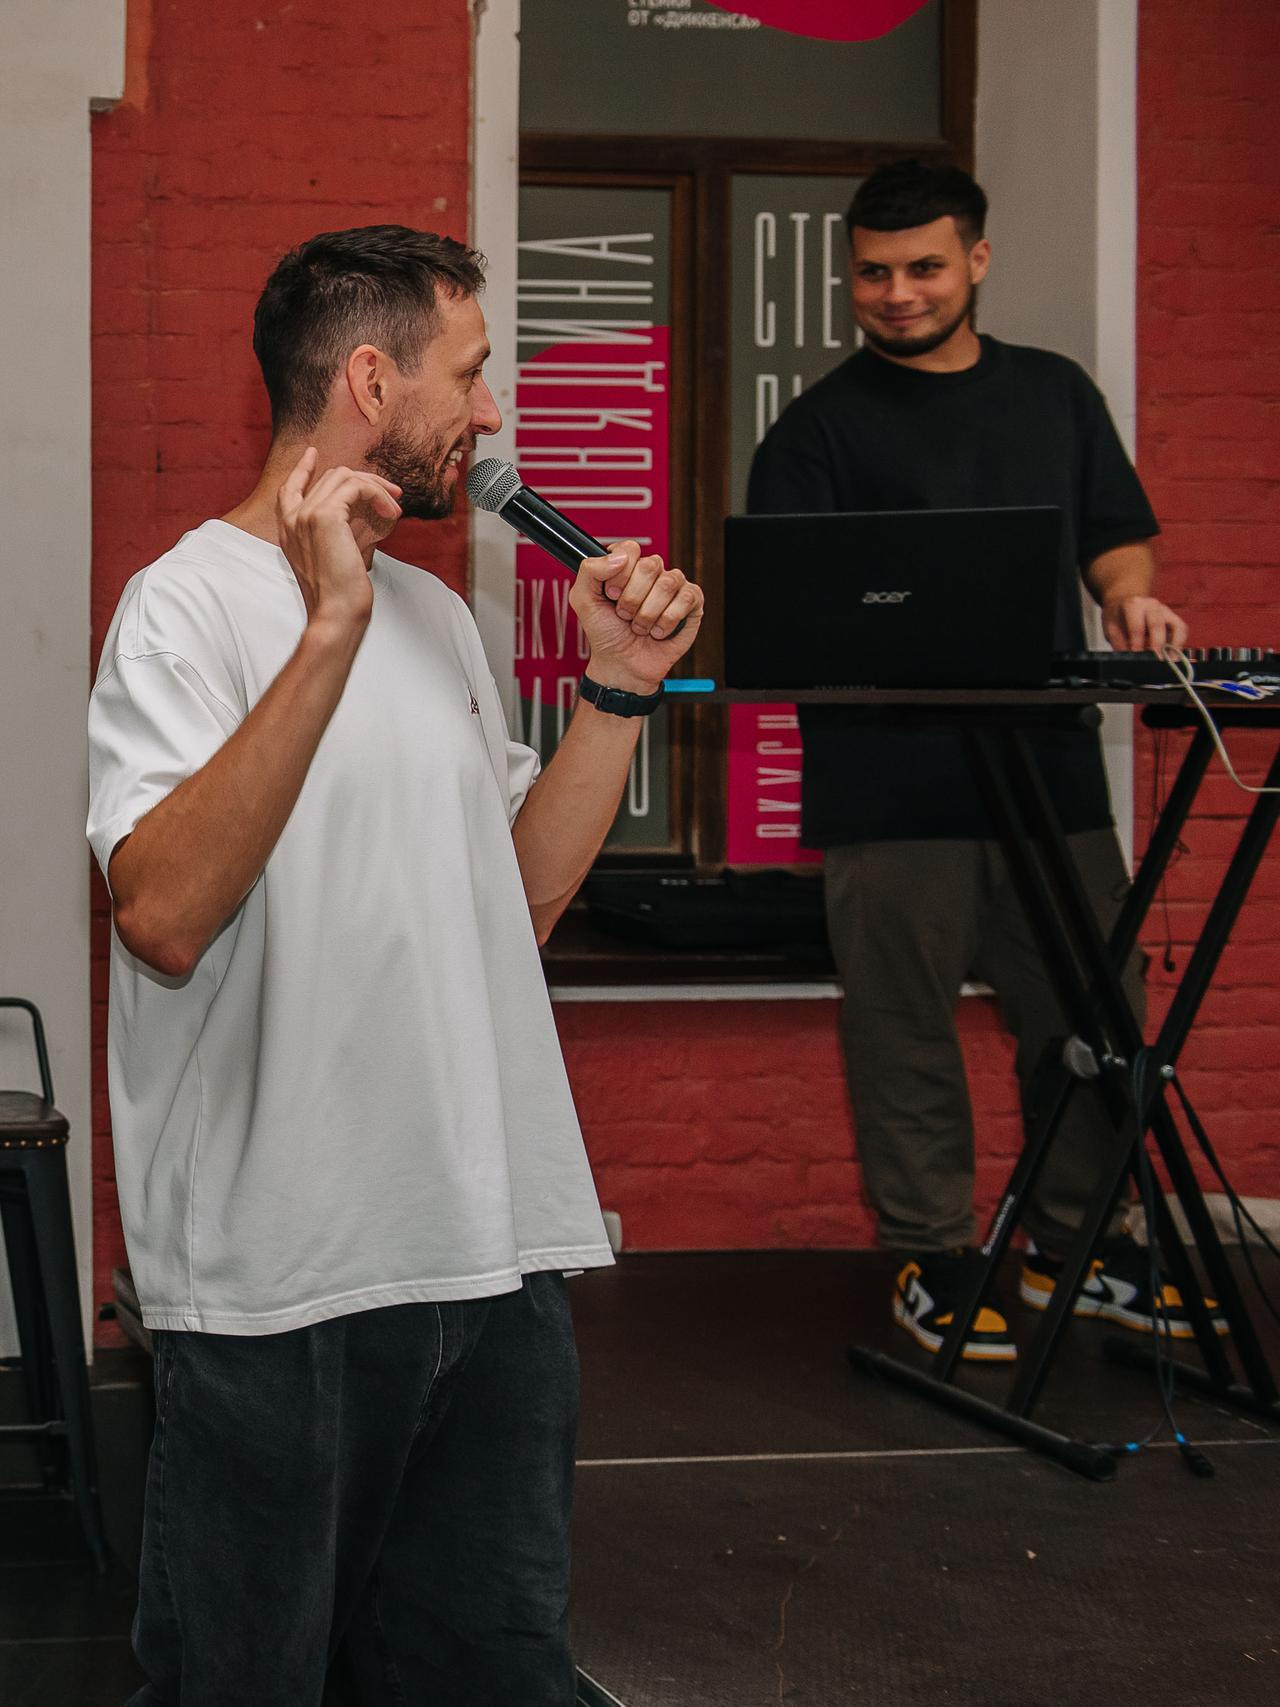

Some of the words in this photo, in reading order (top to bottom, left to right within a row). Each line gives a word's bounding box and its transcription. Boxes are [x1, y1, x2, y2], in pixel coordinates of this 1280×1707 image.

[628, 10, 649, 26] ОТ
[754, 212, 864, 348] СТЕ
[862, 591, 912, 603] acer
